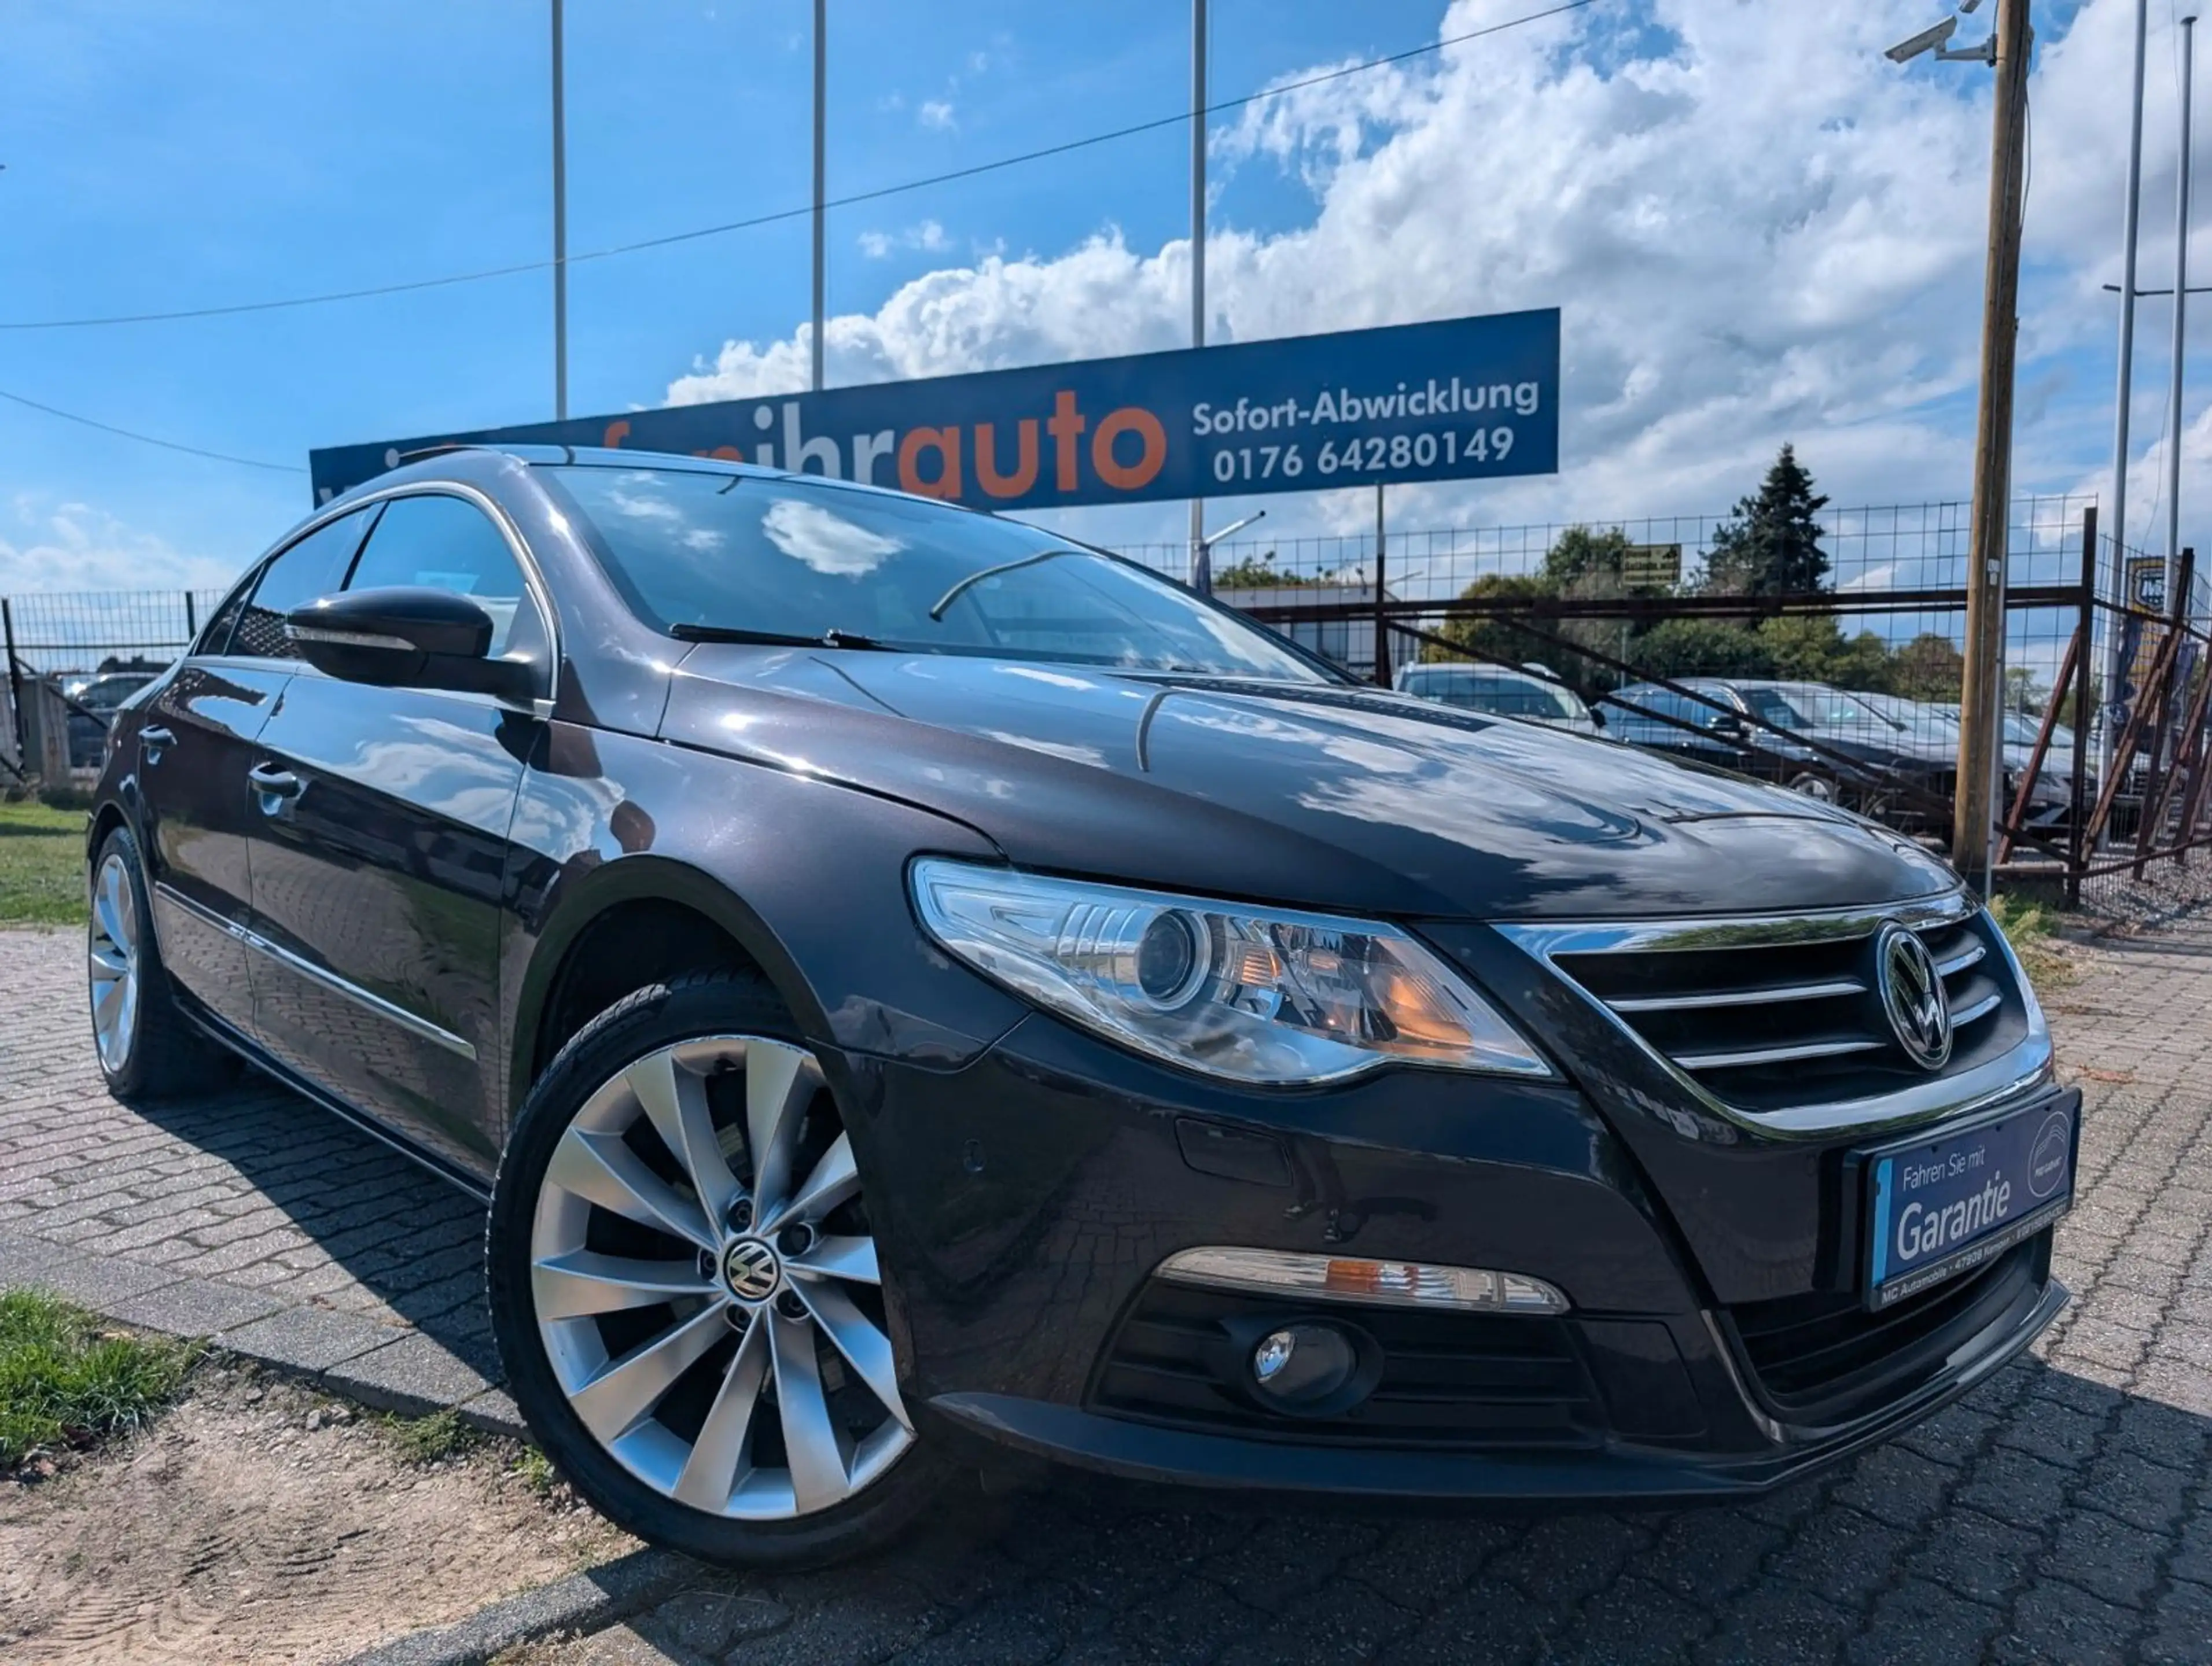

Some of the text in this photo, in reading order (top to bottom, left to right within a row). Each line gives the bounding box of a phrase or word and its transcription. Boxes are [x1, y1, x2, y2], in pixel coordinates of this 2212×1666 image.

[1193, 377, 1539, 436] Sofort-Abwicklung
[1214, 426, 1515, 482] 0176 64280149
[1903, 1144, 1986, 1192] Fahren Sie mit
[1897, 1171, 2011, 1260] Garantie
